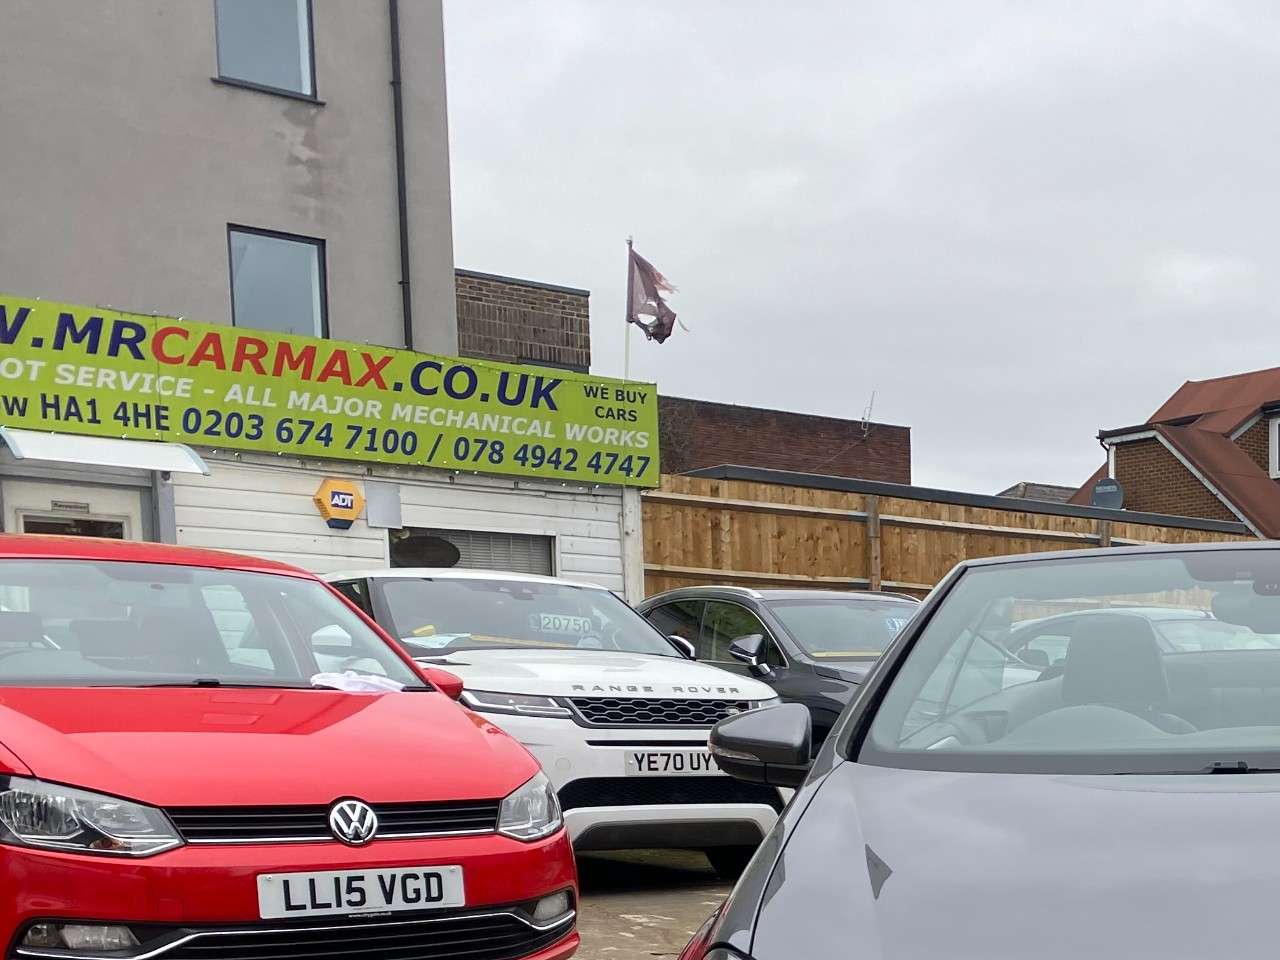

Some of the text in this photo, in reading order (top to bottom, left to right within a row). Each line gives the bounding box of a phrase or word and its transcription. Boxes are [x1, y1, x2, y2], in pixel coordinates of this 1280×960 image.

[584, 385, 647, 405] WE BUY
[54, 363, 195, 397] SERVICE
[224, 383, 277, 408] ALL
[287, 390, 382, 420] MAJOR
[391, 404, 556, 438] MECHANICAL
[565, 422, 649, 449] WORKS
[595, 405, 637, 422] CARS
[40, 393, 101, 424] HA1
[113, 401, 171, 431] 4HE
[182, 407, 264, 441] 0203
[275, 417, 333, 448] 674
[346, 425, 418, 455] 7100
[426, 433, 443, 462] /
[453, 436, 504, 464] 078
[513, 443, 578, 472] 4942
[586, 451, 650, 478] 4747
[331, 494, 353, 507] ADT
[542, 615, 591, 634] 20750
[571, 684, 740, 694] RANGE ROVER
[634, 752, 721, 771] YE70 UY
[283, 872, 444, 912] LL15 VGD
